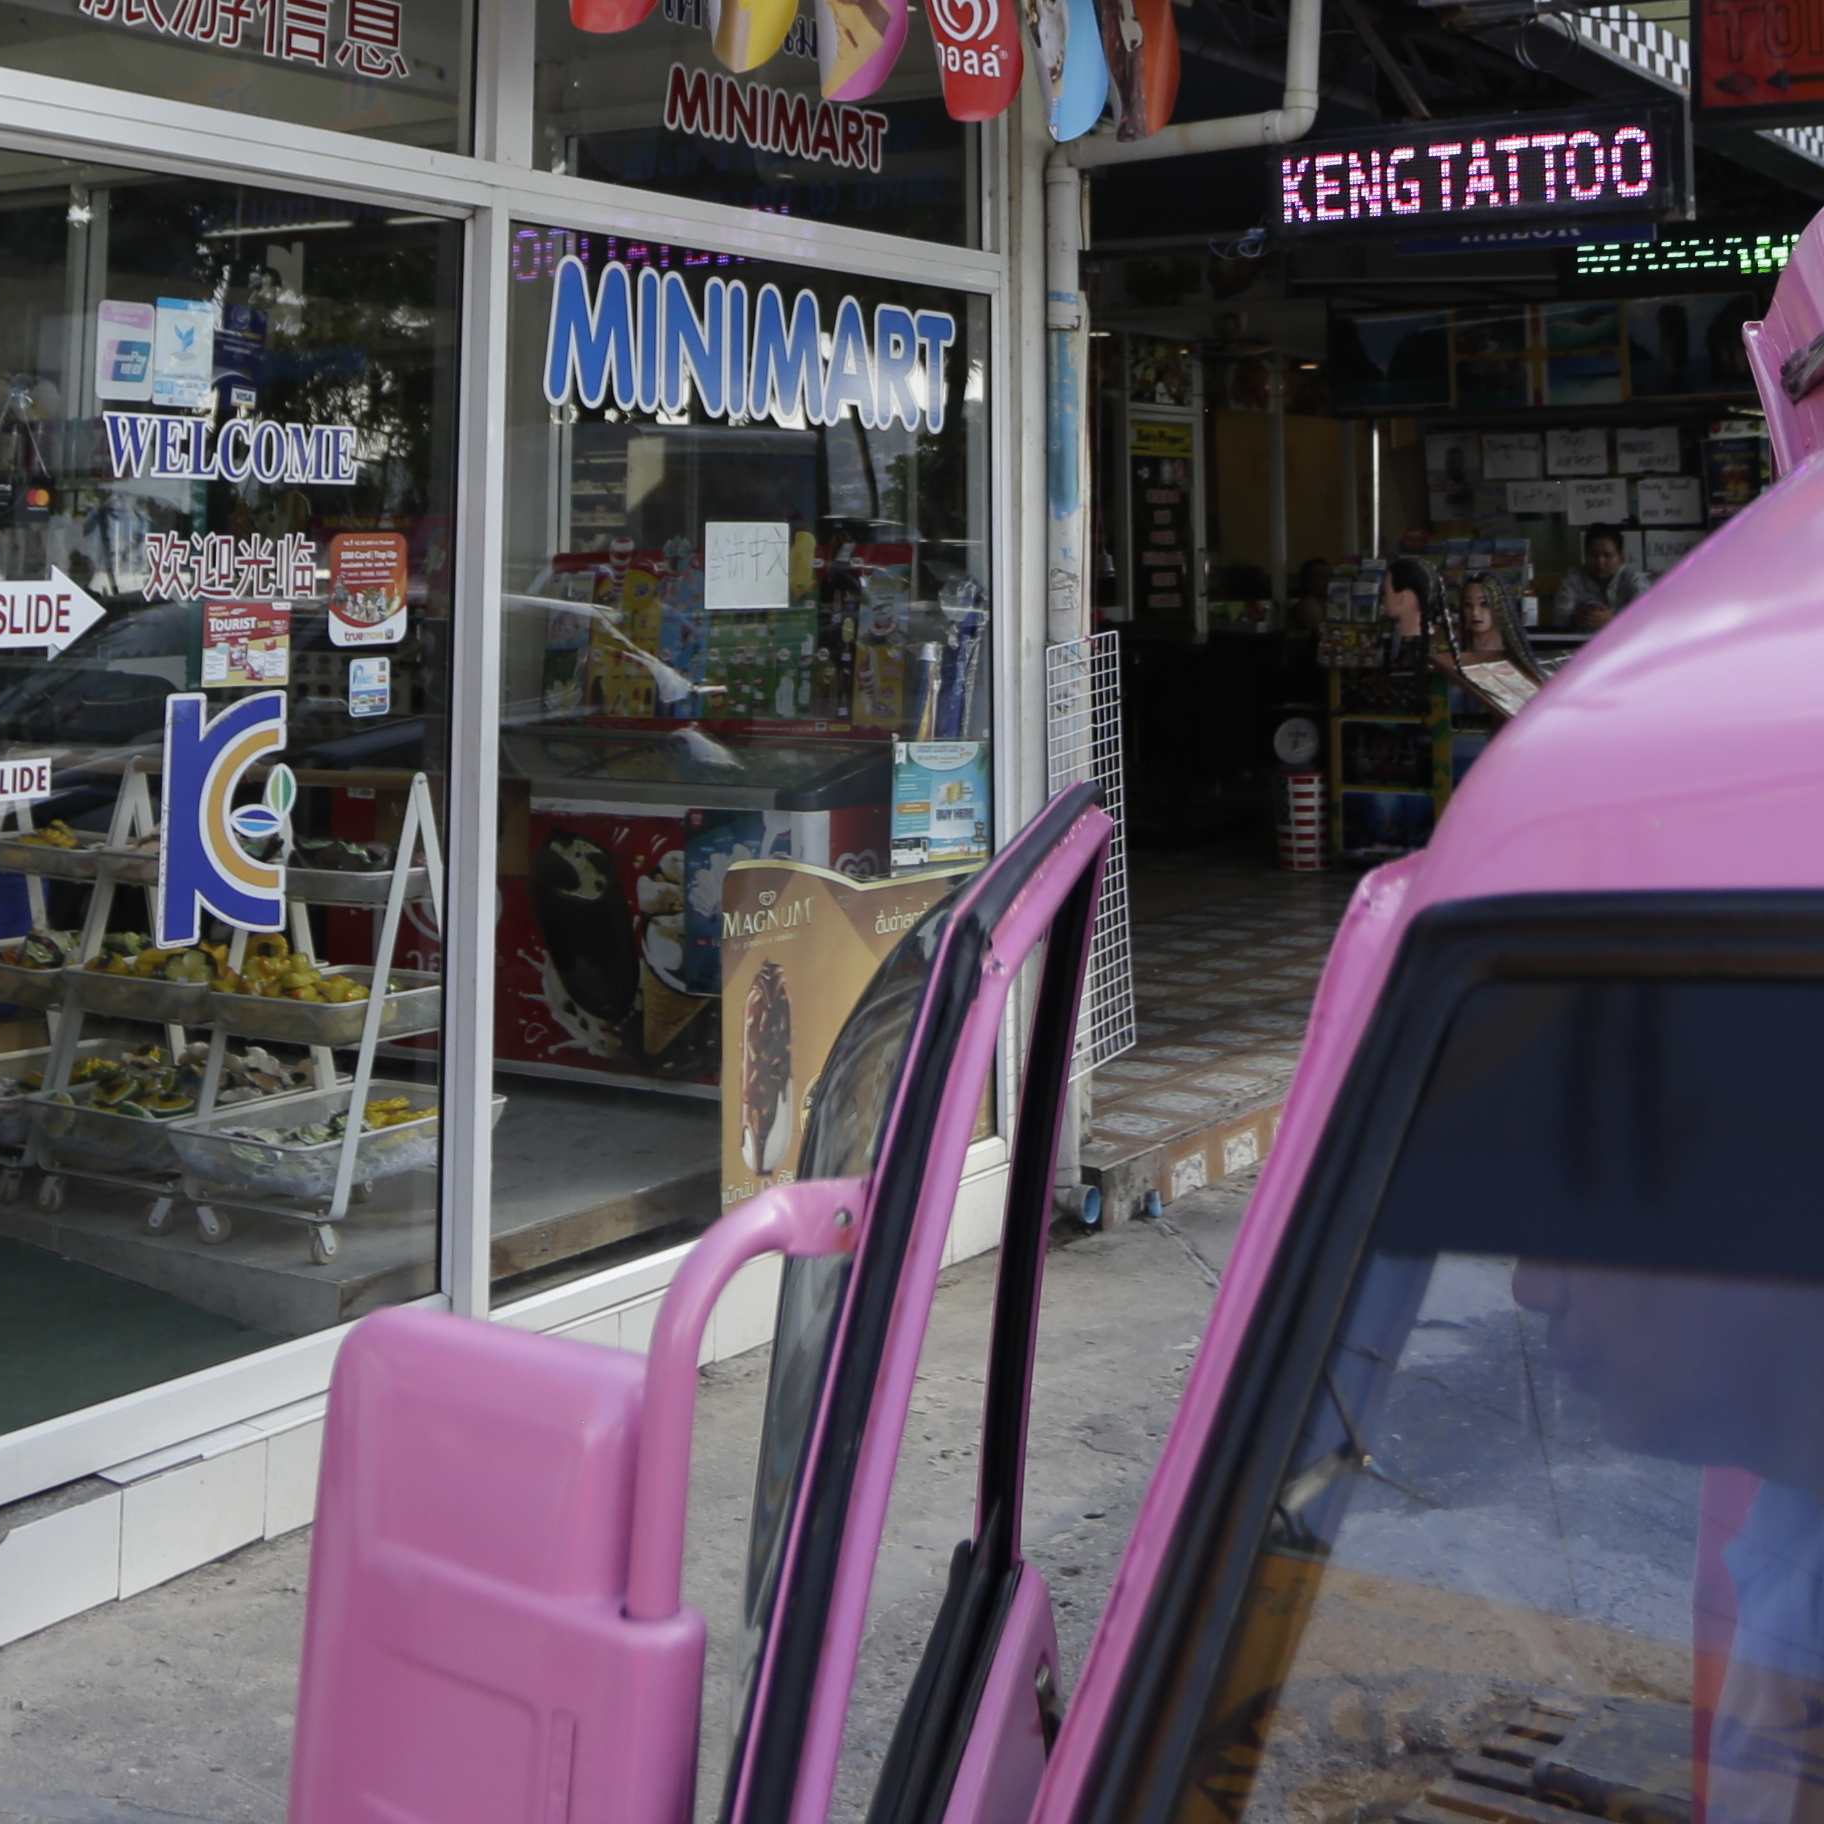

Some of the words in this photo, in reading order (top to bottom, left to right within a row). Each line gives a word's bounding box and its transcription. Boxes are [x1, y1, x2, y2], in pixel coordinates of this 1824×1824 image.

[662, 62, 888, 173] MINIMART
[542, 255, 955, 435] MINIMART
[234, 391, 253, 403] VISA
[101, 409, 358, 485] WELCOME
[142, 530, 317, 601] 欢迎光临
[208, 617, 258, 632] TOURIST
[935, 809, 952, 821] BUY
[954, 807, 975, 819] HERE
[722, 897, 812, 939] MAGNUM
